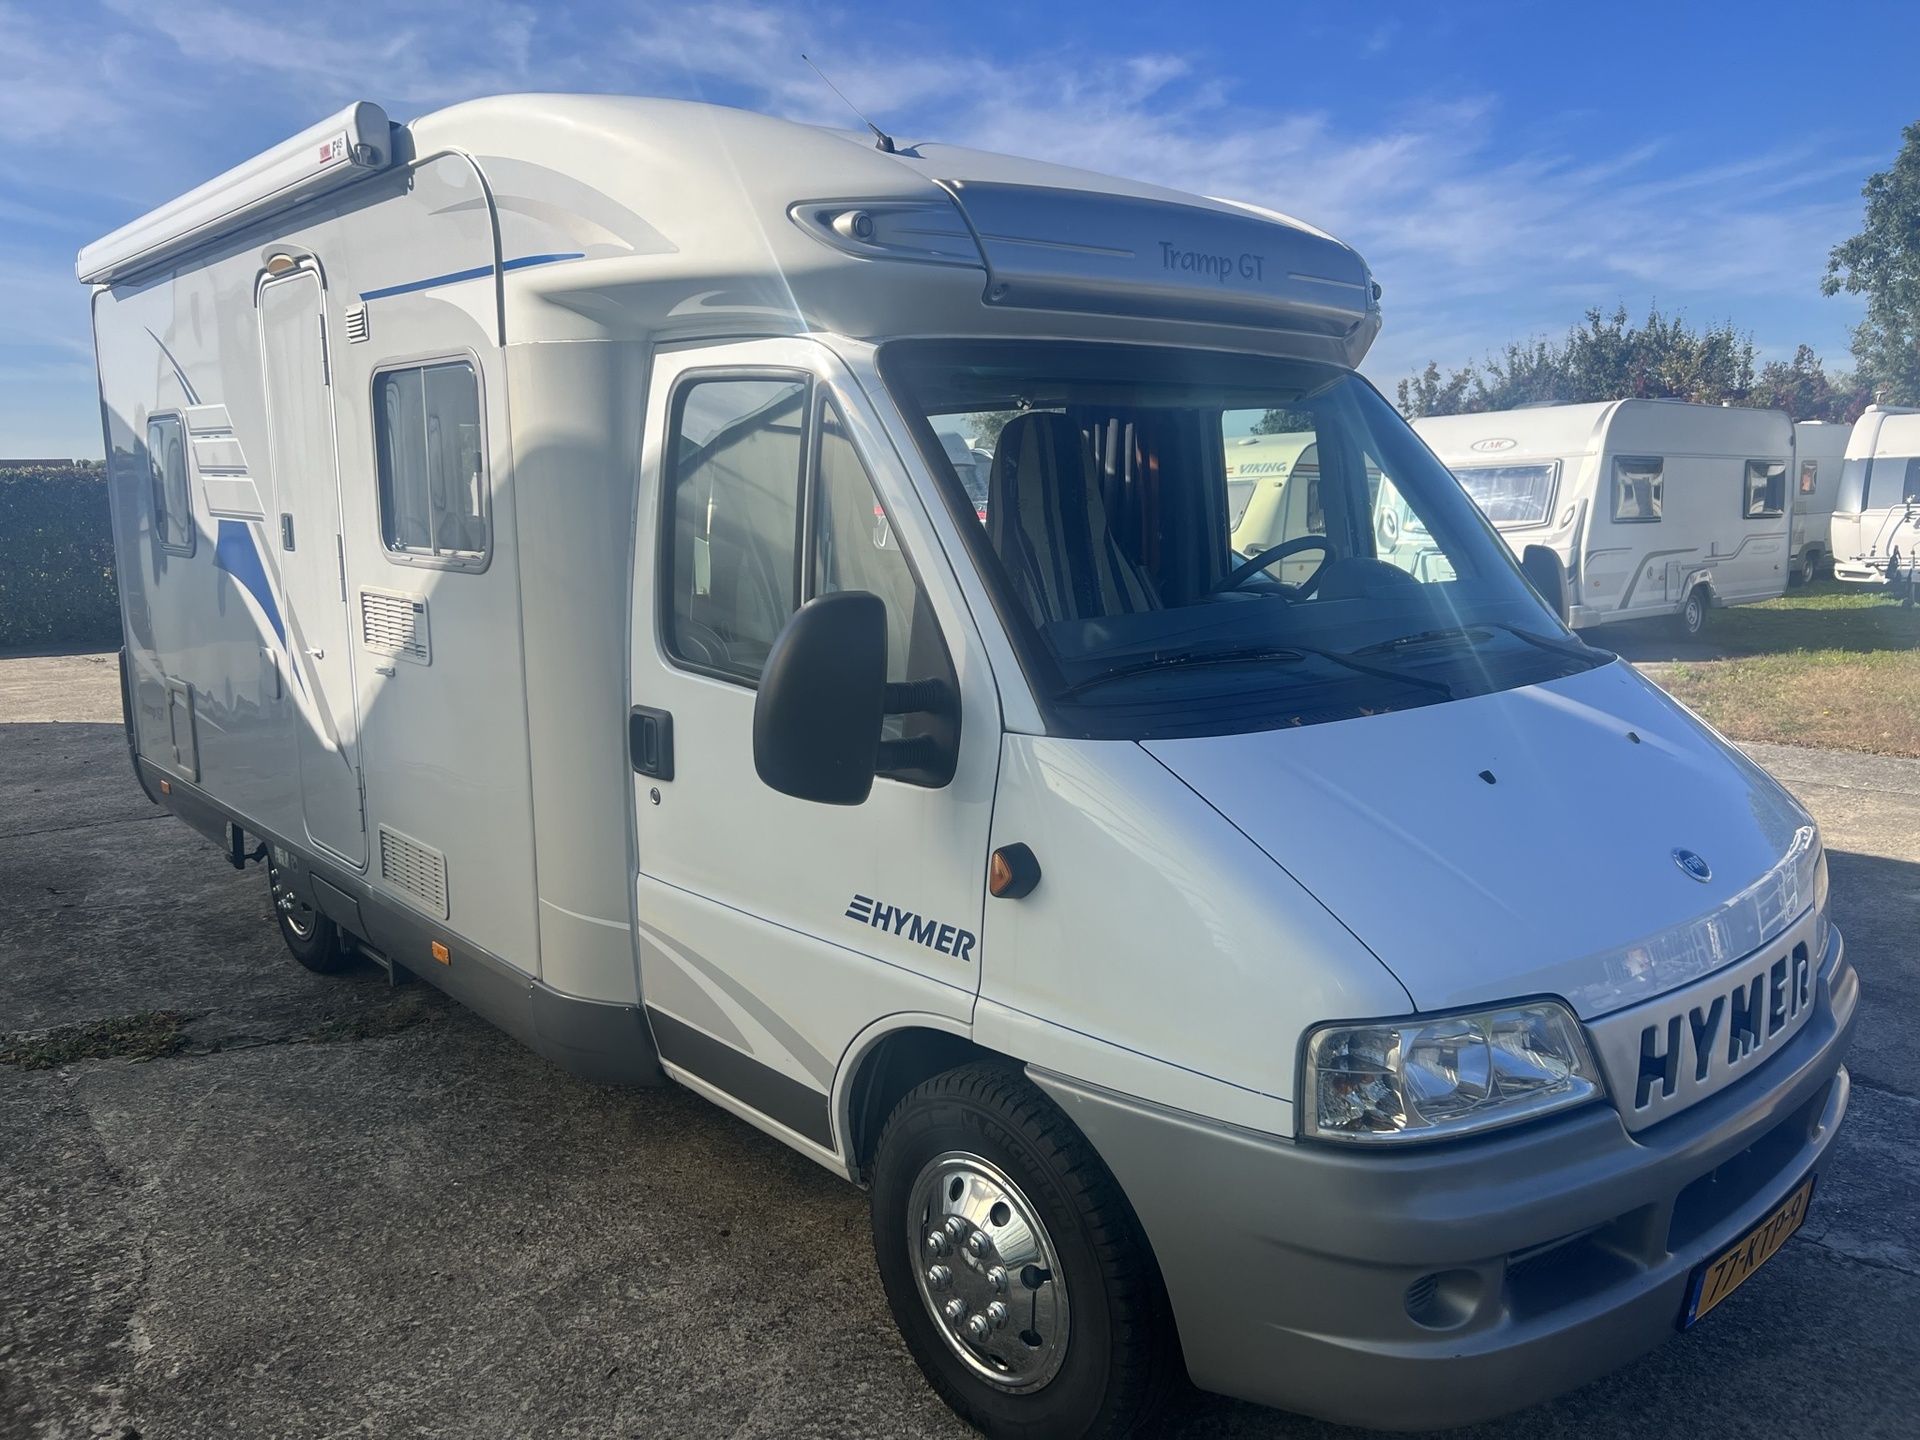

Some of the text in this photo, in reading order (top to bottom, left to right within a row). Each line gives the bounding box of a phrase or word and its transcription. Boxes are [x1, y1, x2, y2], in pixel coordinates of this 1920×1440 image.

[1159, 241, 1264, 284] Tramp GT
[1480, 440, 1508, 450] LMC
[1240, 461, 1287, 475] VIKING
[1684, 855, 1706, 871] FIAT
[871, 901, 976, 962] HYMER
[1634, 941, 1809, 1111] HYMER
[1708, 1193, 1803, 1304] 77-KTP-9
